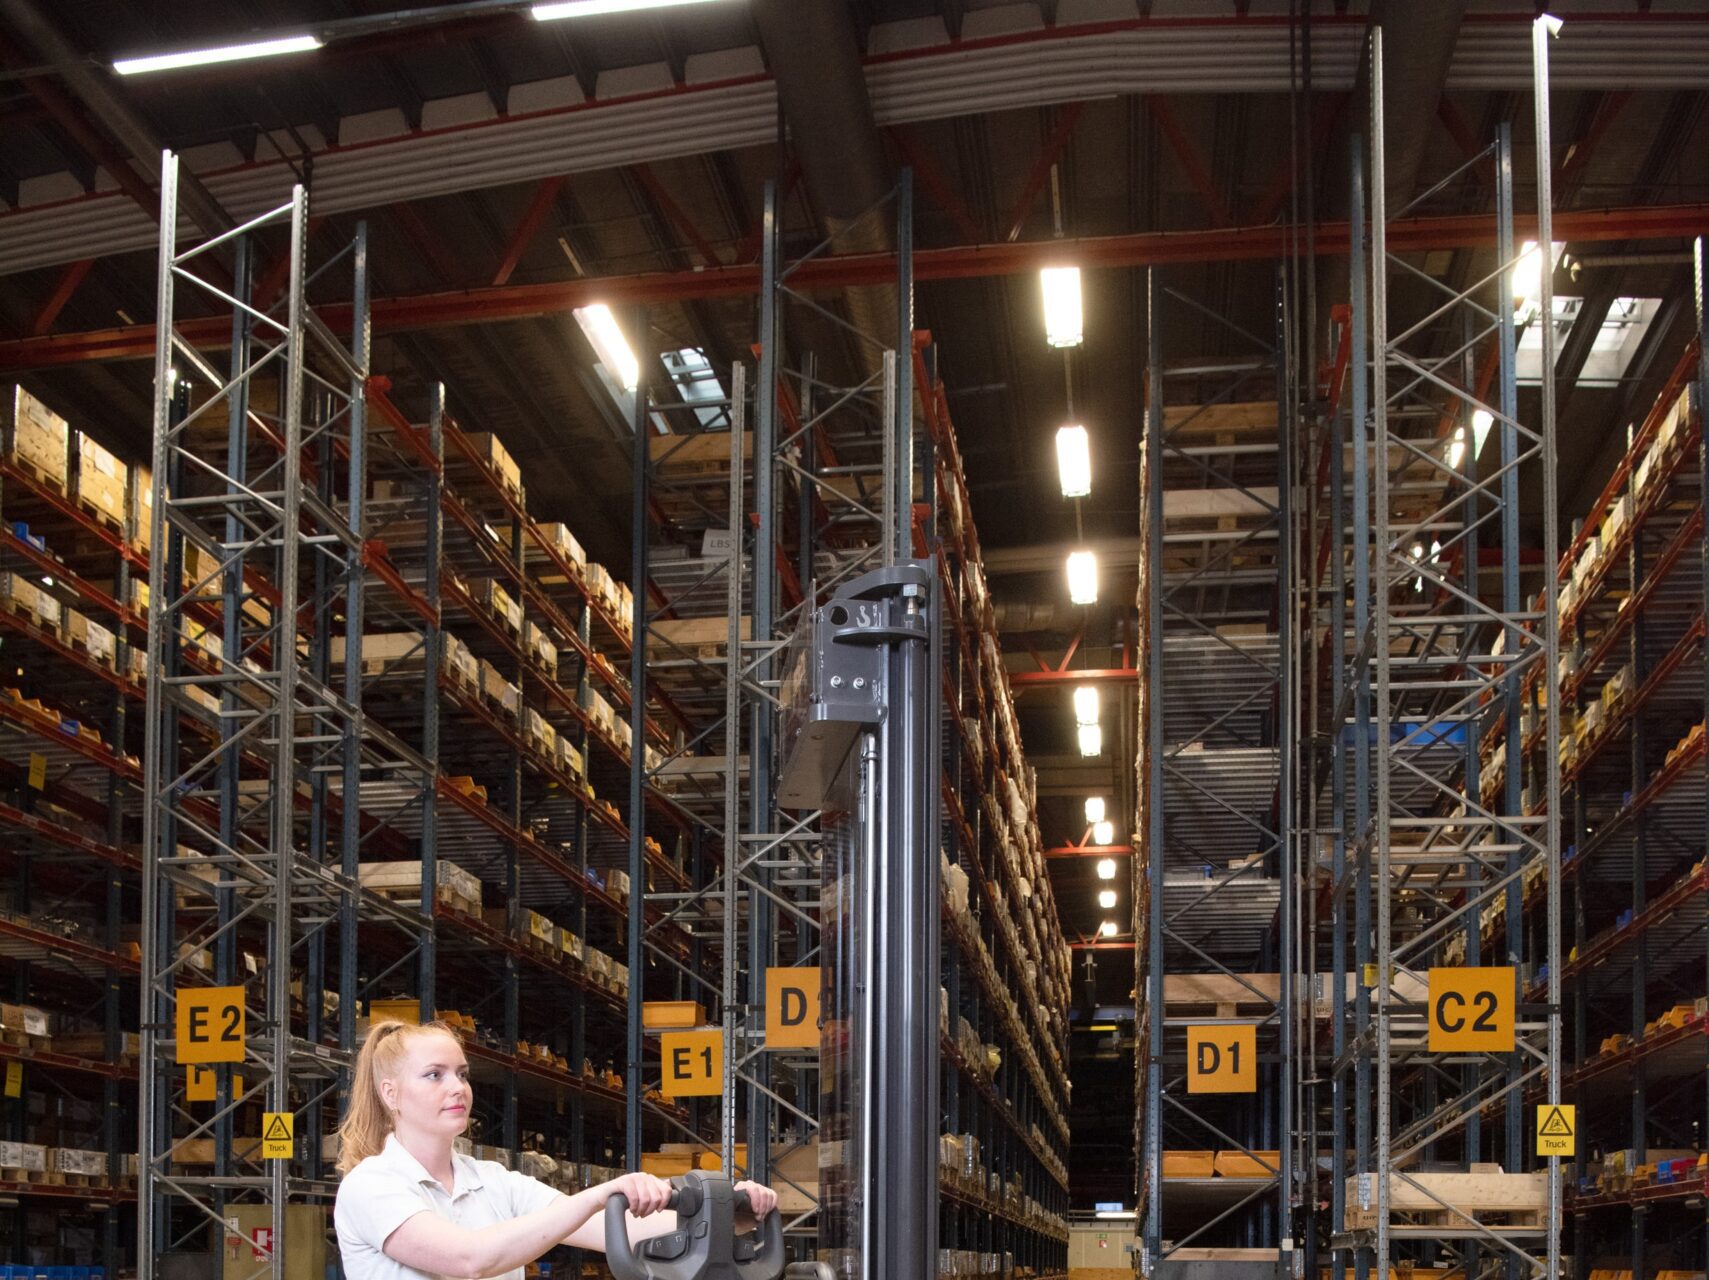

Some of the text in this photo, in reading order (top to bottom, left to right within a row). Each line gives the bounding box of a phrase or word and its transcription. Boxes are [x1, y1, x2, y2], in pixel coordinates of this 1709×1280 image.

[1435, 991, 1498, 1032] C2
[672, 1046, 713, 1080] E1
[1197, 1041, 1240, 1074] D1
[268, 1144, 287, 1152] Truck
[1544, 1139, 1567, 1148] Truck
